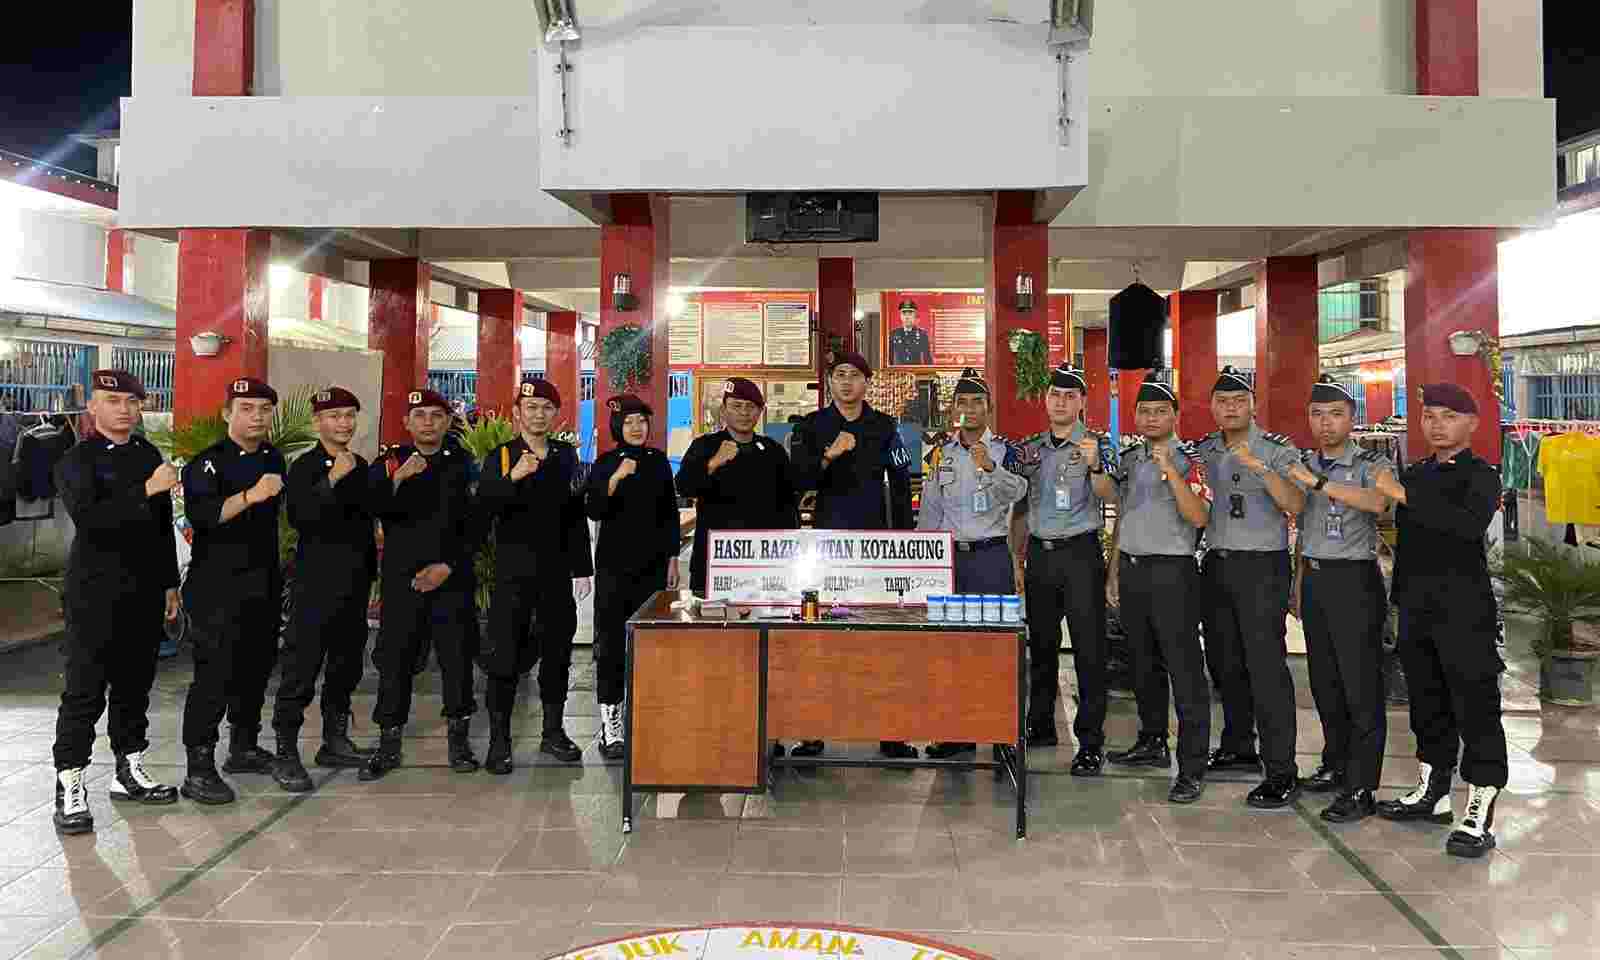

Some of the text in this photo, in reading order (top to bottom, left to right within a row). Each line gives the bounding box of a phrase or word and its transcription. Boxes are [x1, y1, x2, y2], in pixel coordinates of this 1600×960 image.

[714, 539, 754, 560] HASIL
[760, 539, 801, 560] RAZI
[861, 539, 945, 560] KOTAAGUNG
[739, 930, 859, 954] AMAN
